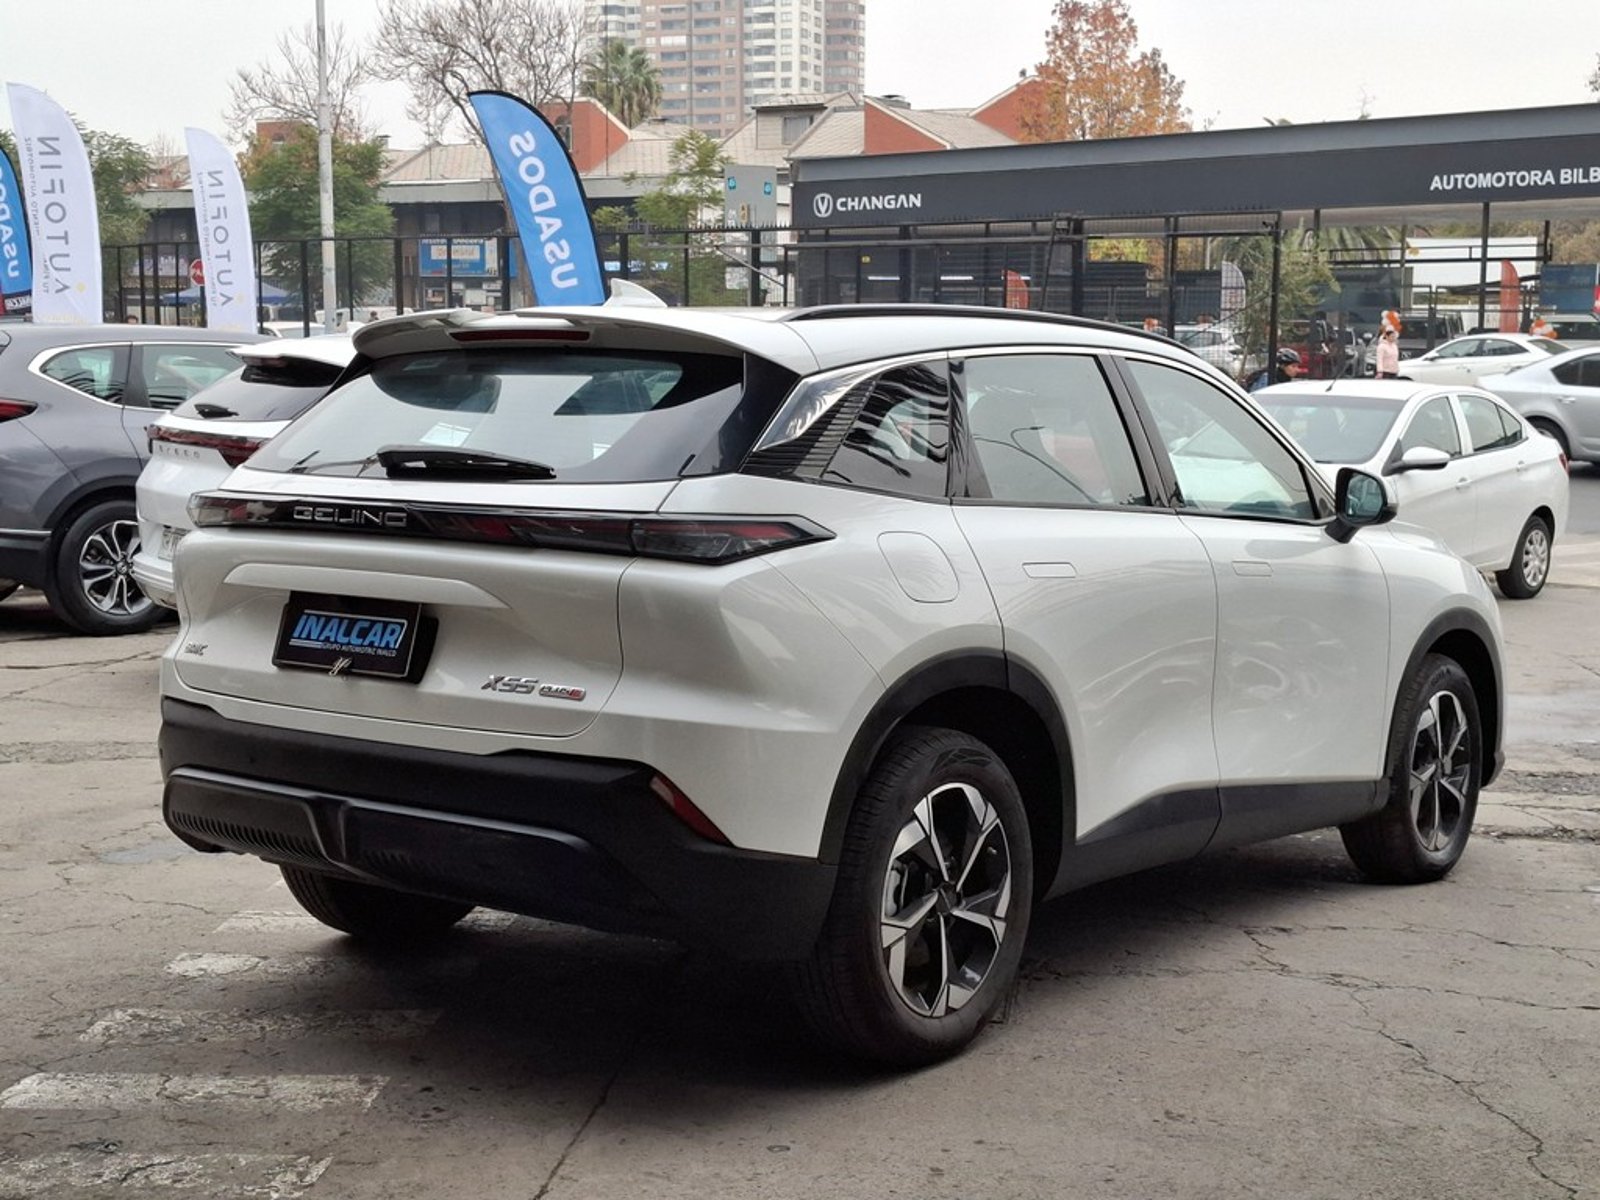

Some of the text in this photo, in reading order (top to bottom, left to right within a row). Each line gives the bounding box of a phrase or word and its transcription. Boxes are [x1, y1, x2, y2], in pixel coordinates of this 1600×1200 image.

[1429, 166, 1600, 191] AUTOMOTORA BILB
[836, 193, 922, 211] CHANGAN
[292, 614, 402, 650] INALCAR
[480, 674, 540, 695] X55
